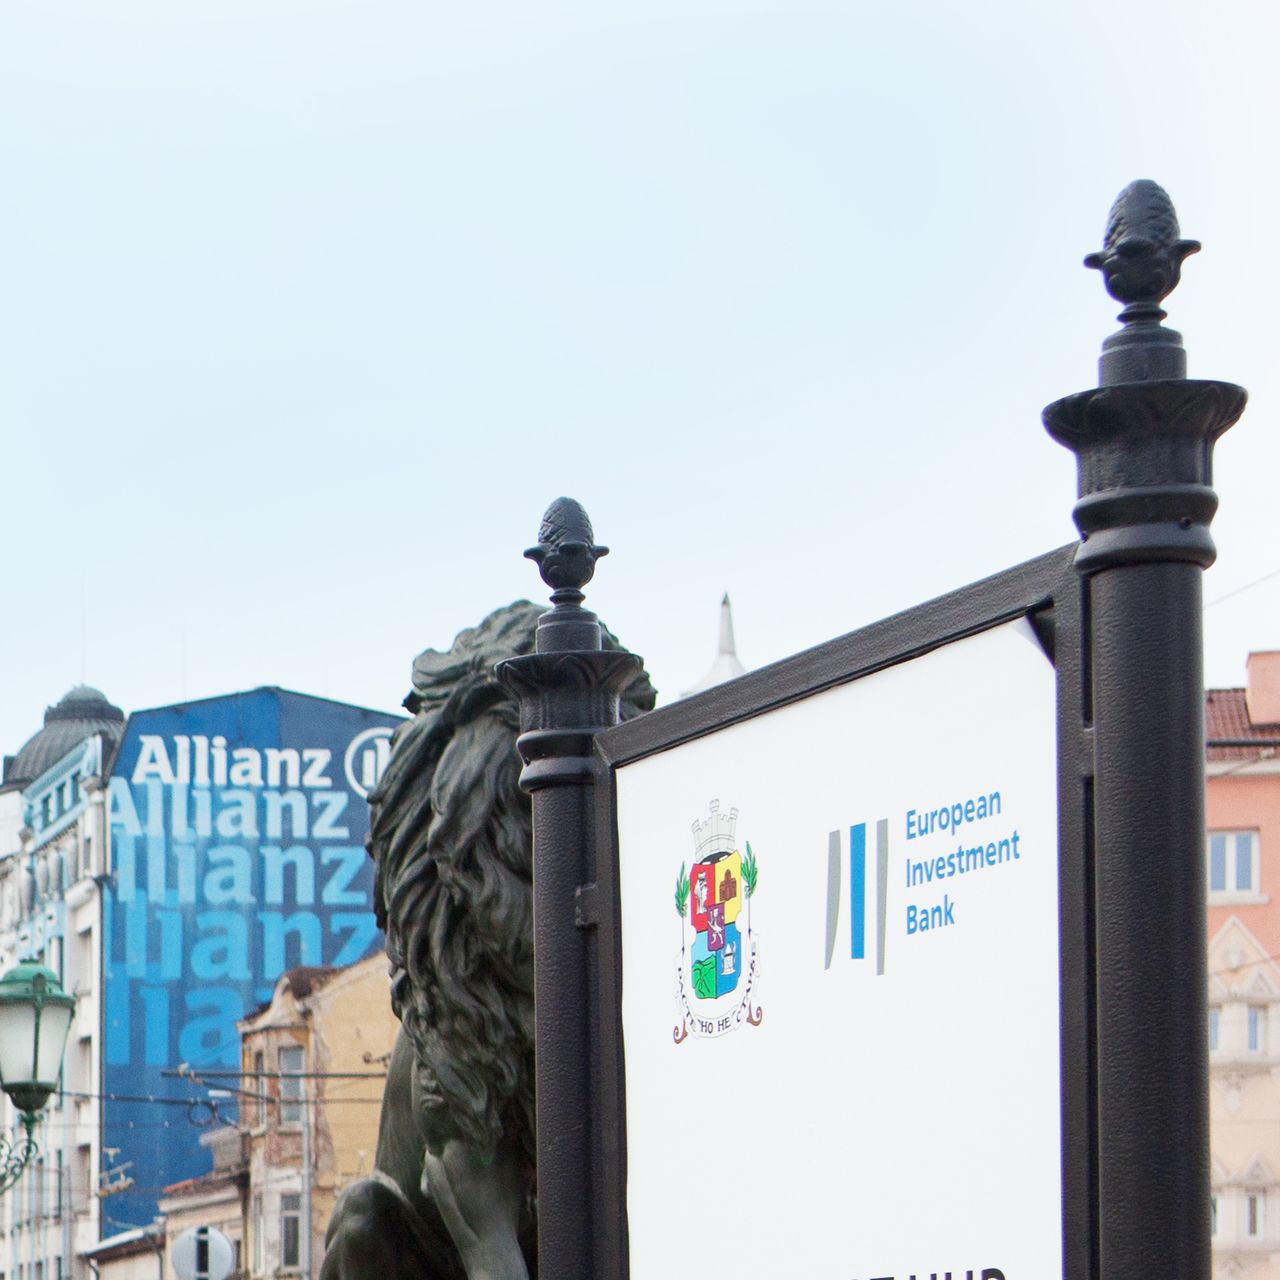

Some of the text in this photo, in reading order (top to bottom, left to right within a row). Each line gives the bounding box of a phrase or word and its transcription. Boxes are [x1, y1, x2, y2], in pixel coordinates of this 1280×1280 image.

[131, 734, 334, 788] Allianz
[108, 775, 351, 840] Allianz
[906, 791, 1001, 840] European
[906, 830, 1020, 887] Investment
[907, 894, 955, 935] Bank
